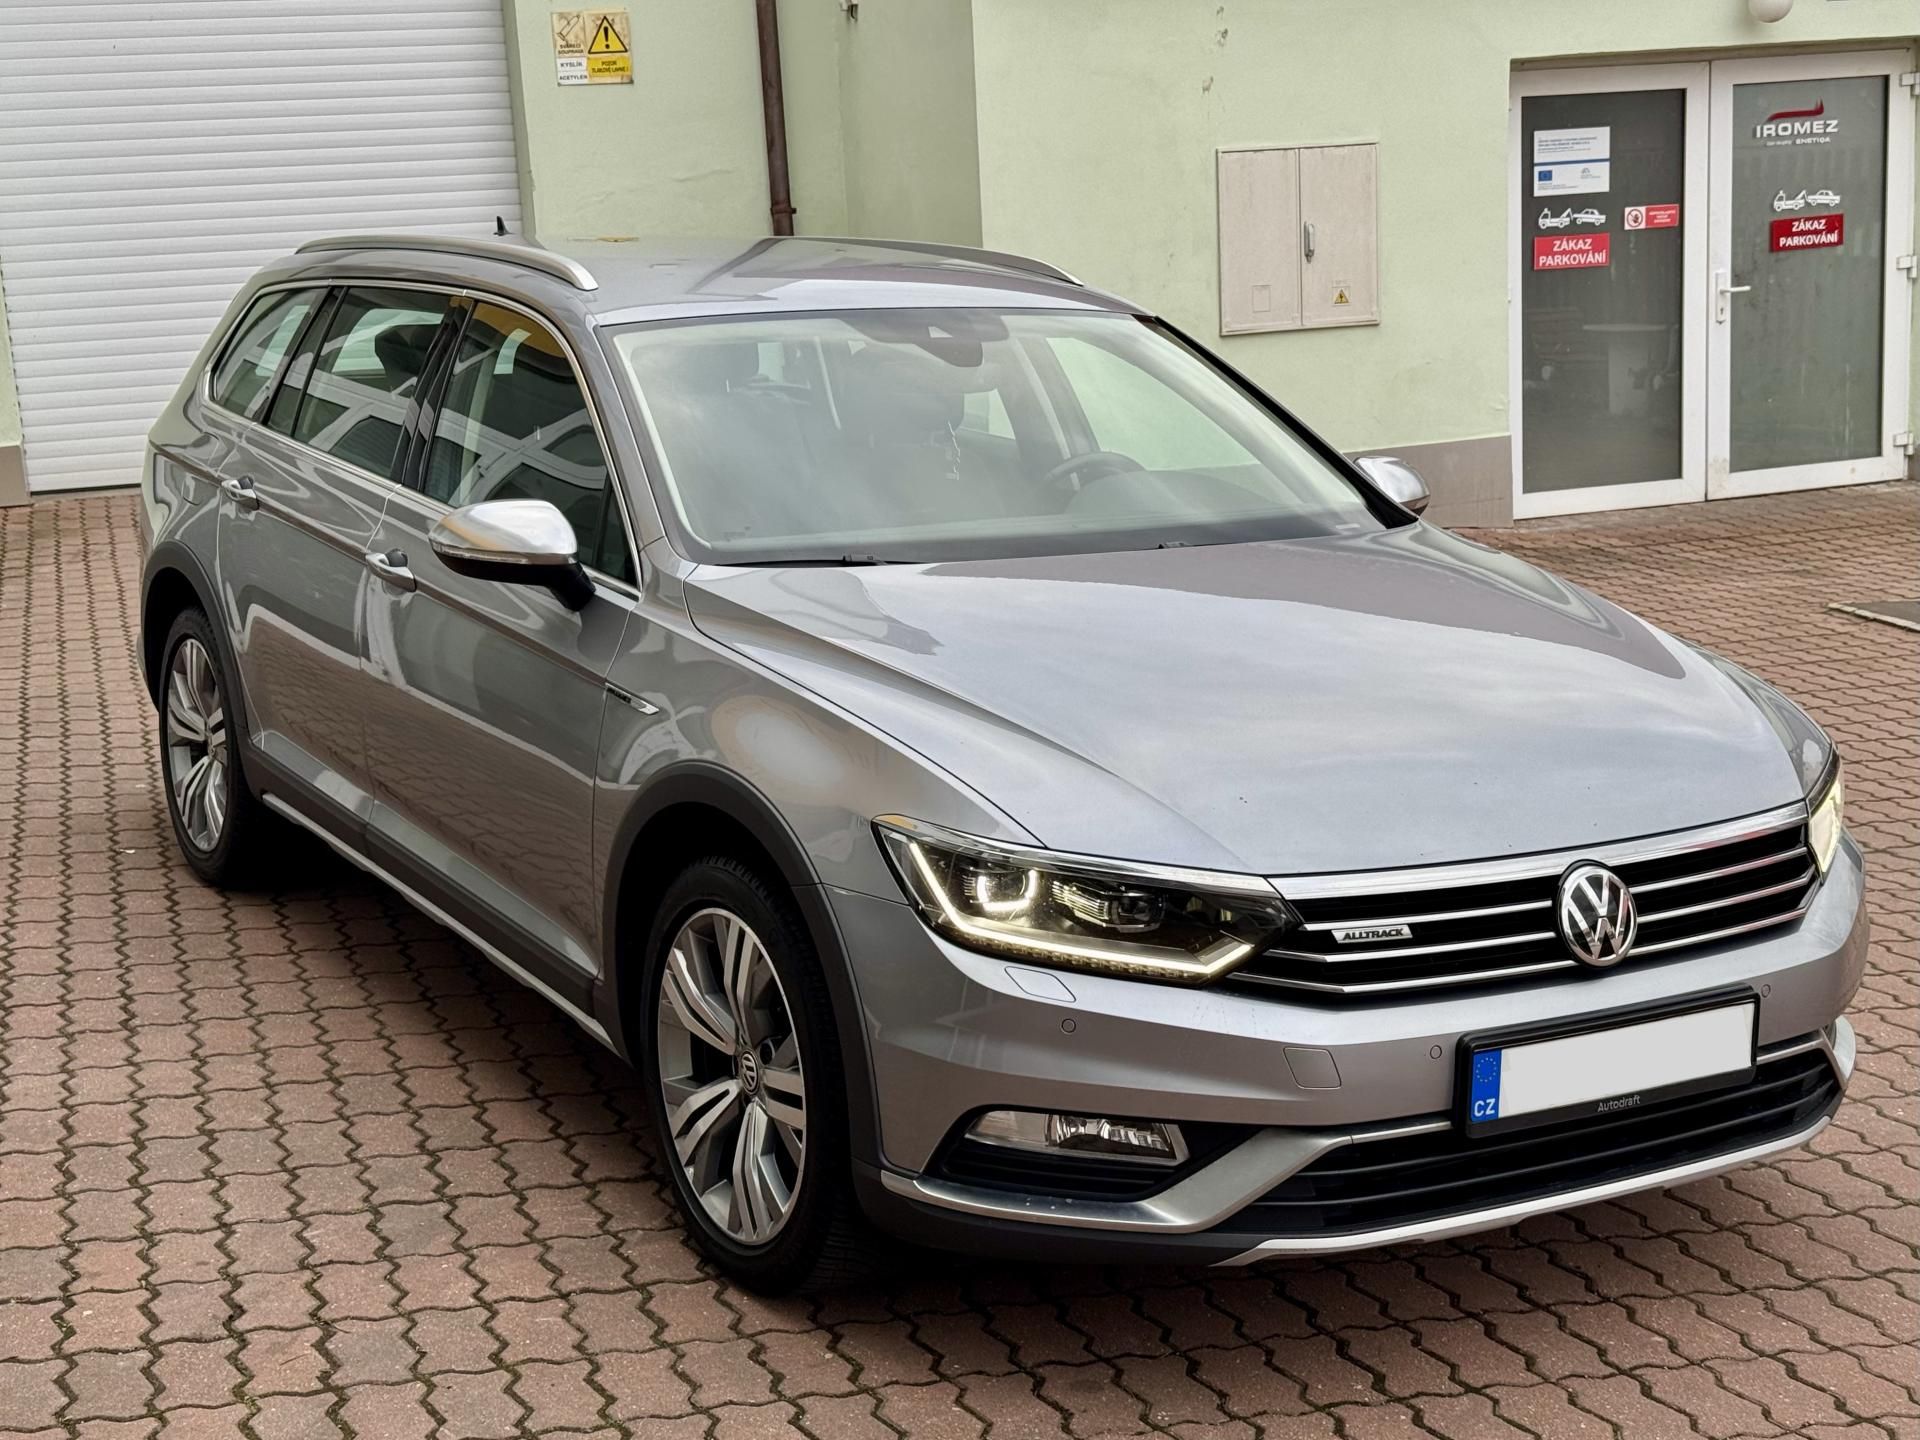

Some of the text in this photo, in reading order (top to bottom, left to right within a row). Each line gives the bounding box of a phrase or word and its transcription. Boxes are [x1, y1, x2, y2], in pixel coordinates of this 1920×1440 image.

[1756, 119, 1839, 138] IROMEZ
[1792, 218, 1826, 232] ZÁKAZ
[1553, 238, 1593, 252] ZÁKAZ
[1779, 230, 1838, 248] PARKOVÁNÍ
[1539, 249, 1606, 267] PARKOVÁNÍ
[1342, 927, 1405, 941] ALLTRACK
[1474, 1098, 1496, 1118] CZ
[1597, 1094, 1641, 1113] Autodraft
